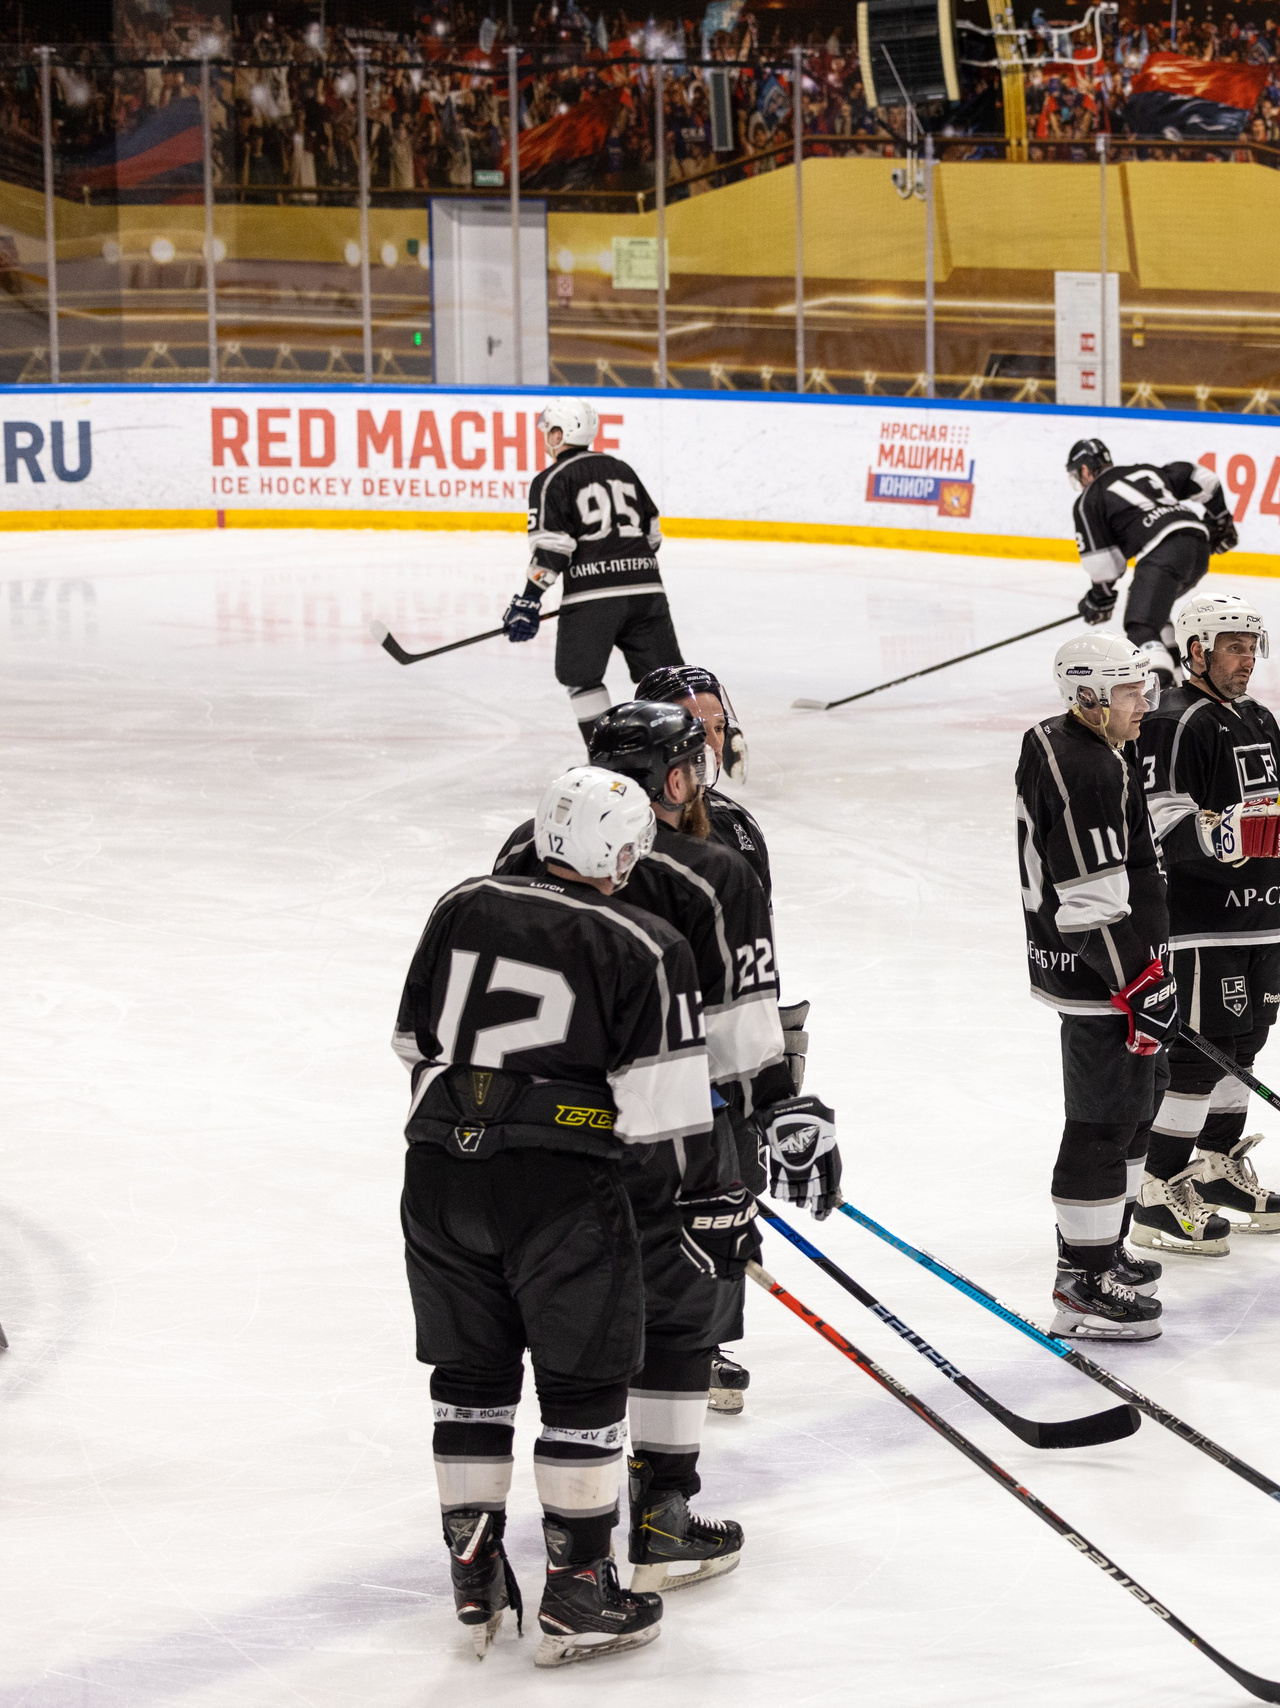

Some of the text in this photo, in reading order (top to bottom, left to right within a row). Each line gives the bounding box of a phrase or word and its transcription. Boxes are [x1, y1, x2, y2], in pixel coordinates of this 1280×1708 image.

[3, 420, 93, 483] RU
[211, 407, 624, 472] RED MACHIE
[877, 443, 965, 472] МАШИНА
[211, 476, 530, 499] ICE HOCKEY DEVELOPMENT
[879, 475, 935, 499] ЮНИОР
[527, 507, 539, 531] 5
[575, 478, 644, 542] 95
[1075, 531, 1086, 552] 3
[1066, 667, 1093, 676] BAUER
[547, 833, 565, 856] 12
[529, 881, 566, 893] LUTCH
[736, 937, 777, 993] 22
[1143, 976, 1178, 1009] BAU
[434, 948, 578, 1070] 12
[554, 1104, 616, 1131] CC
[869, 1361, 913, 1397] BAUER
[1062, 1532, 1171, 1621] BAUER
